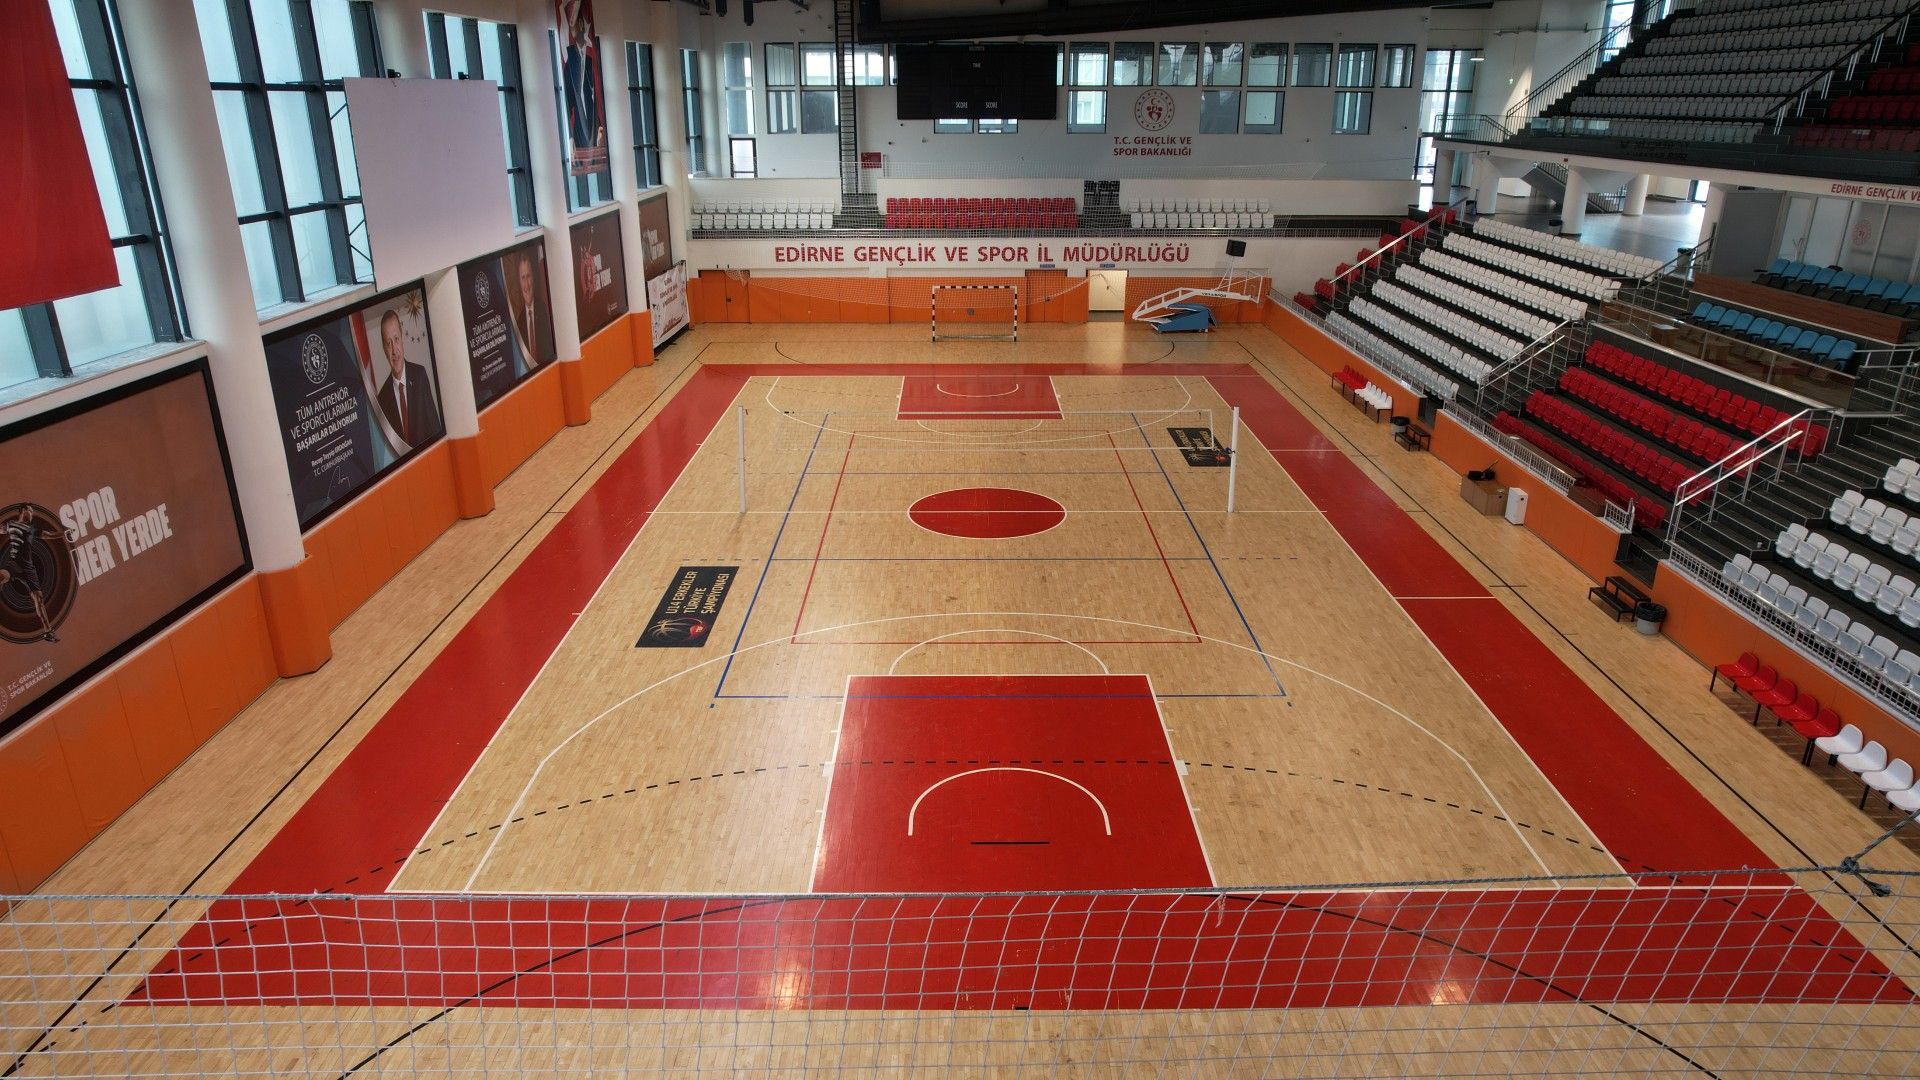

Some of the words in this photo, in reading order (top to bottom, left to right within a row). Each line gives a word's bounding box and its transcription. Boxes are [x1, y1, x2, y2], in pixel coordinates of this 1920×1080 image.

[955, 101, 968, 109] SCORE
[985, 101, 998, 109] SCORE
[1113, 147, 1138, 156] SPOR
[1140, 146, 1192, 156] BAKANLIĞI
[1114, 136, 1131, 145] T.C.
[1134, 134, 1176, 147] GENÇLİK
[1179, 136, 1192, 145] VE
[1831, 183, 1863, 196] EDİRNE
[1866, 186, 1907, 200] GENÇLİK
[774, 243, 844, 262] EDİRNE
[853, 243, 936, 266] GENÇLİK
[944, 246, 968, 262] VE
[977, 246, 1028, 262] SPOR
[1037, 243, 1053, 262] İL
[1063, 242, 1189, 262] MÜDÜRLÜĞÜ
[296, 404, 314, 421] TÜM
[314, 386, 350, 413] ANTRENÖR
[290, 425, 302, 440] VE
[301, 396, 358, 435] SPORCULARIMIZA
[296, 428, 329, 452] BAŞARILAR
[328, 411, 358, 434] DİLİYORUM
[59, 485, 121, 543] SPOR
[70, 534, 116, 588] HER
[112, 503, 173, 562] YERDE
[672, 570, 699, 600] ERKEKLER
[700, 573, 730, 614] ŞAMPİYONASI
[665, 600, 682, 614] U14
[683, 587, 707, 614] TÜRKİYE
